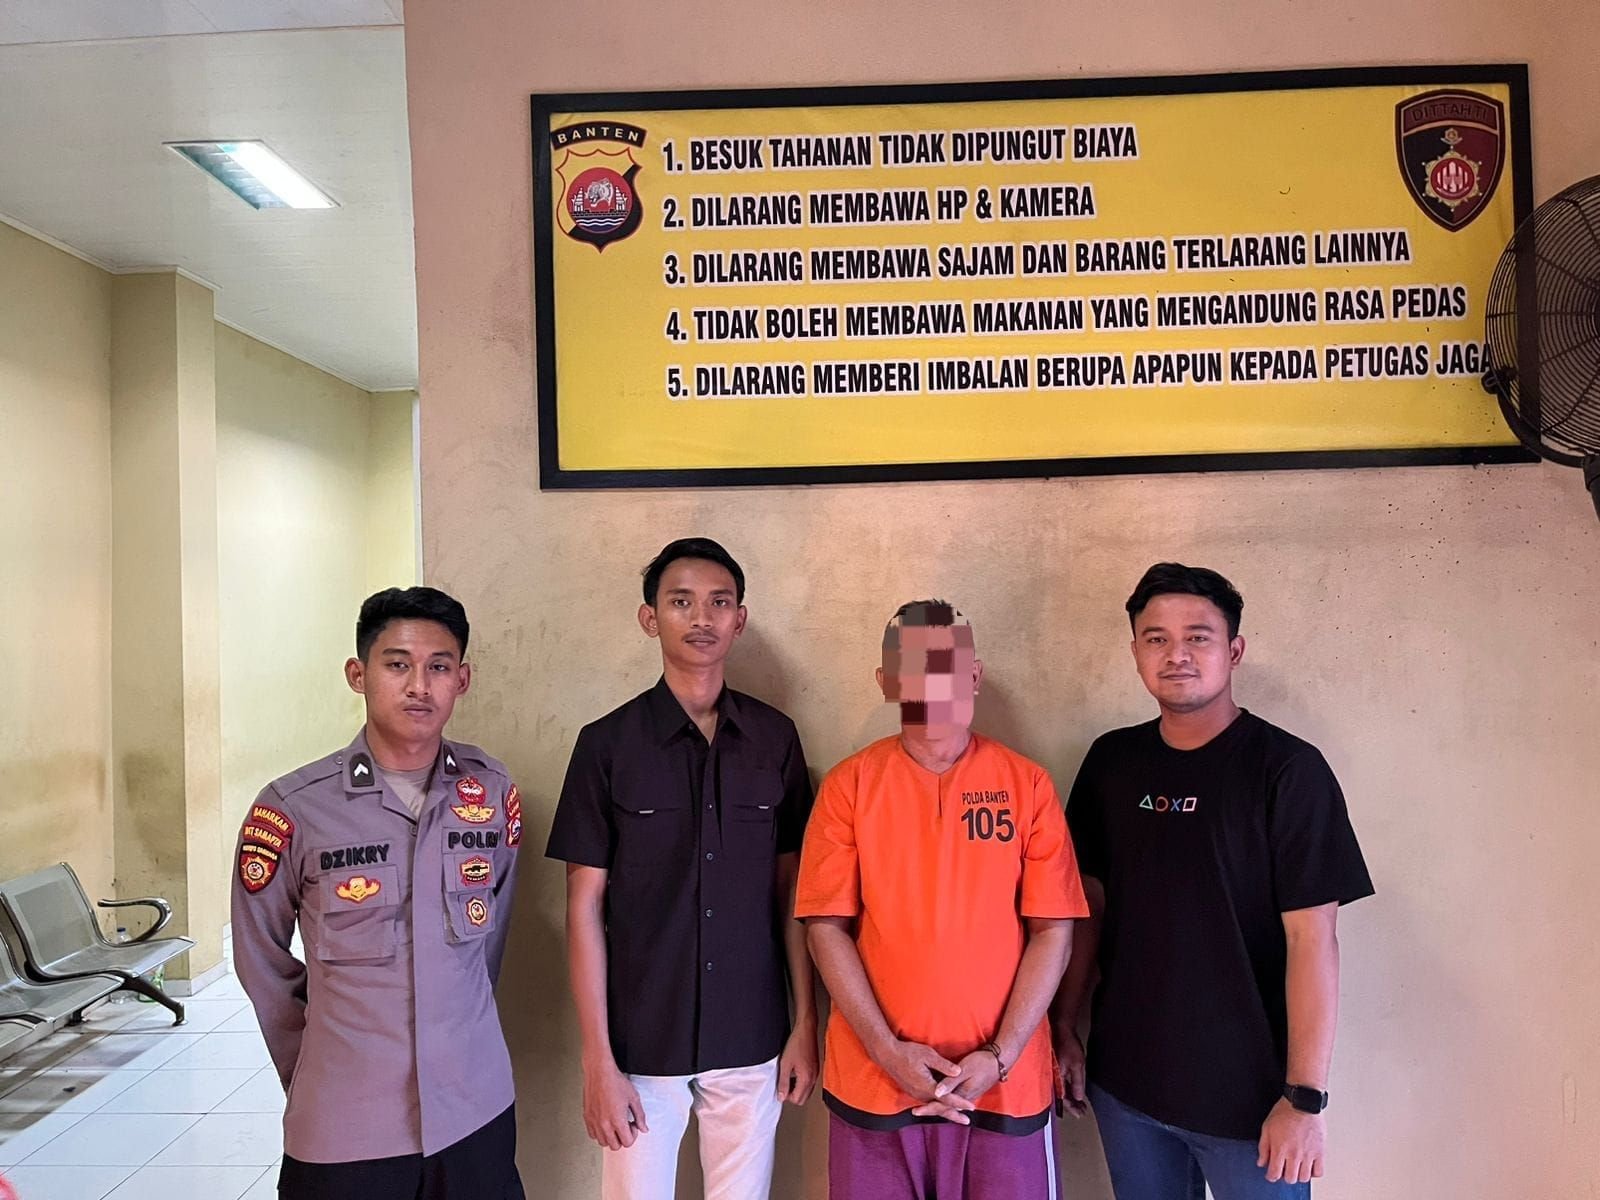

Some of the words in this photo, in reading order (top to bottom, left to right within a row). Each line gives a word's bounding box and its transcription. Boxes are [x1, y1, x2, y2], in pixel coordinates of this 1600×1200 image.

[557, 126, 639, 144] BANTEN
[663, 142, 683, 171] 1.
[690, 139, 763, 171] BESUK
[768, 135, 872, 168] TAHANAN
[878, 133, 946, 165] TIDAK
[952, 128, 1066, 162] DIPUNGUT
[1073, 126, 1137, 159] BIAYA
[663, 198, 684, 228] 2.
[692, 194, 802, 227] DILARANG
[809, 190, 930, 224] MEMBAWA
[937, 190, 968, 220] HP
[975, 188, 993, 219] &
[1000, 186, 1095, 218] KAMERA
[665, 254, 685, 285] 3.
[693, 251, 803, 284] DILARANG
[811, 248, 931, 281] MEMBAWA
[938, 245, 1014, 277] SAJAM
[1022, 243, 1067, 274] DAN
[1075, 240, 1166, 273] BARANG
[1173, 234, 1306, 269] TERLARANG
[1314, 231, 1409, 264] LAINNYA
[666, 311, 687, 341] 4.
[693, 309, 759, 340] TIDAK
[766, 307, 837, 339] BOLEH
[846, 303, 966, 337] MEMBAWA
[973, 300, 1083, 333] MAKANAN
[1090, 297, 1149, 329] YANG
[1157, 291, 1317, 327] MENGANDUNG
[1325, 289, 1385, 321] RASA
[1392, 286, 1466, 319] PEDAS
[668, 368, 688, 397] 5.
[696, 364, 805, 396] DILARANG
[813, 362, 920, 394] MEMBERI
[928, 358, 1029, 391] IMBALAN
[1037, 355, 1126, 387] BERUPA
[1132, 352, 1222, 385] APAPUN
[1230, 349, 1318, 381] KEPADA
[1325, 344, 1429, 378] PETUGAS
[1435, 343, 1492, 375] JAGA
[962, 791, 984, 805] POLDA
[961, 807, 1015, 842] 105
[320, 844, 390, 870] DZIKRY
